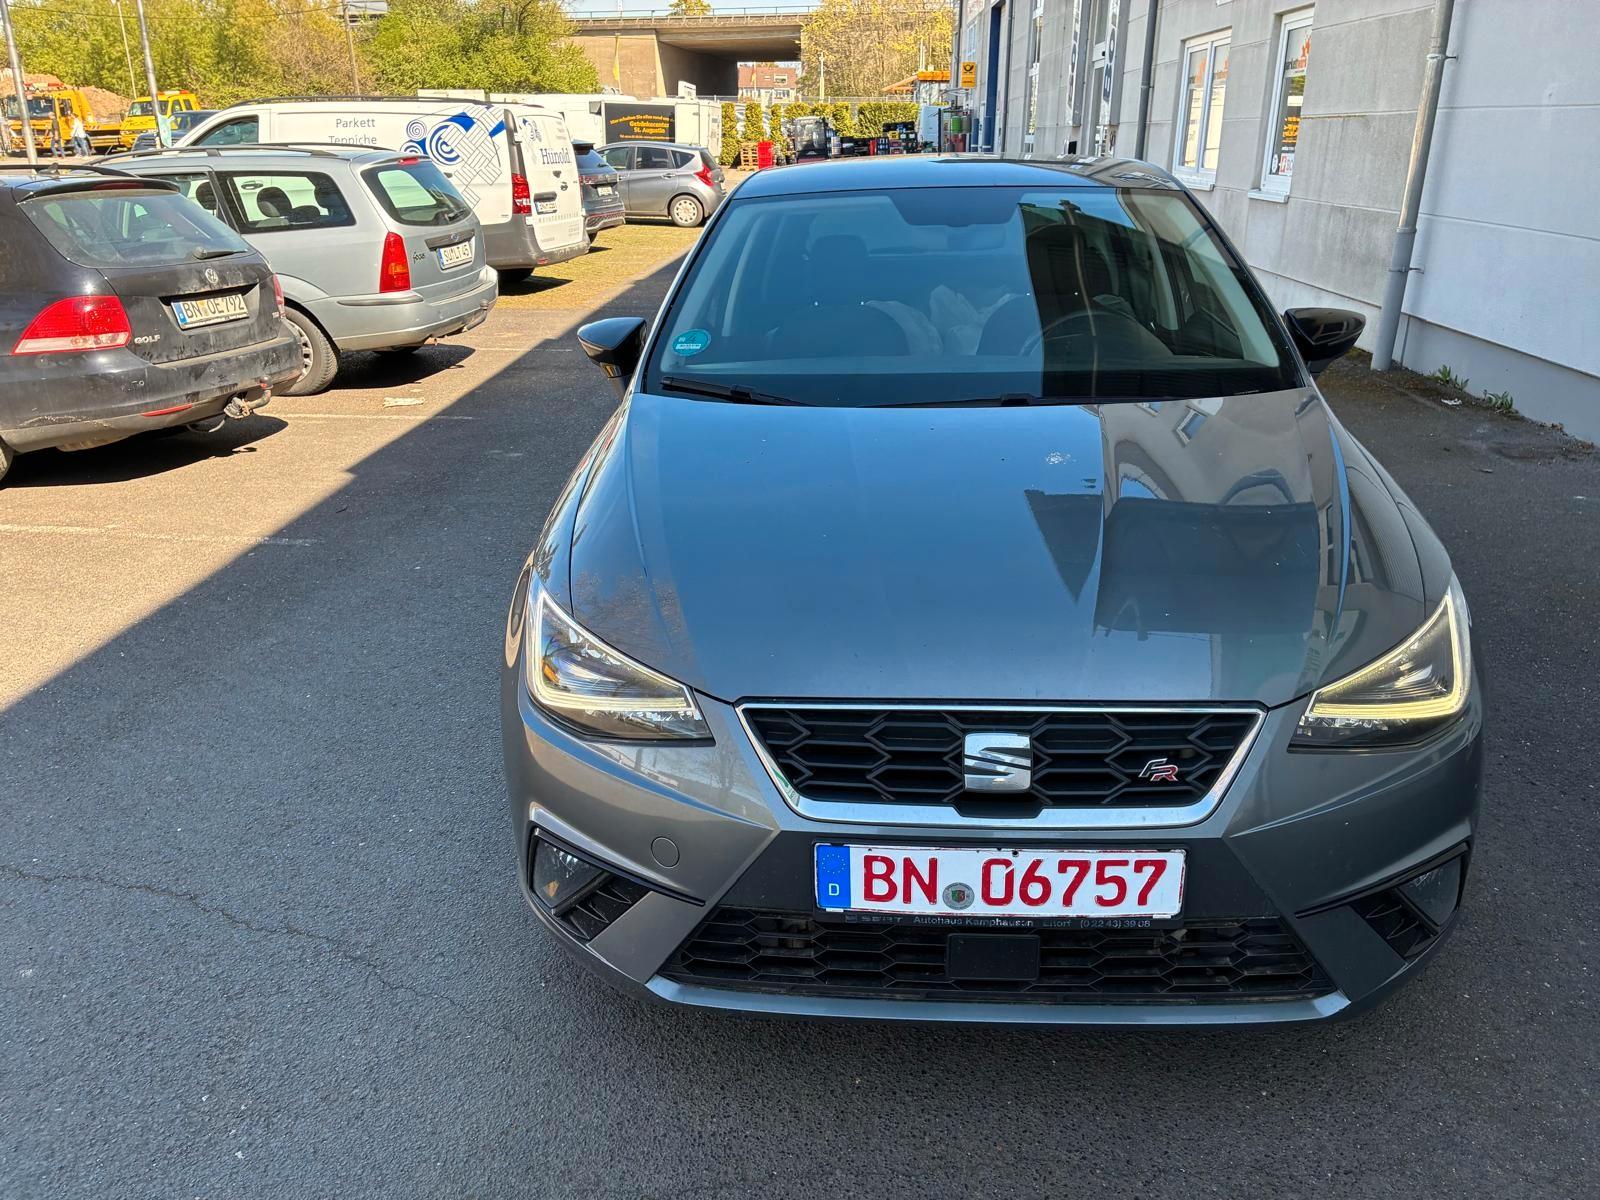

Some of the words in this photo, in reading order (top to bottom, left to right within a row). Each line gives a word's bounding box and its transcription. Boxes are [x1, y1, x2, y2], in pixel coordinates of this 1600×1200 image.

[336, 117, 376, 128] Parkett
[183, 301, 203, 319] BN
[134, 335, 161, 345] GOLF
[1138, 757, 1178, 782] FR
[863, 855, 938, 904] BN
[981, 859, 1168, 908] 06757
[828, 883, 840, 896] D
[913, 915, 963, 925] Autohaus
